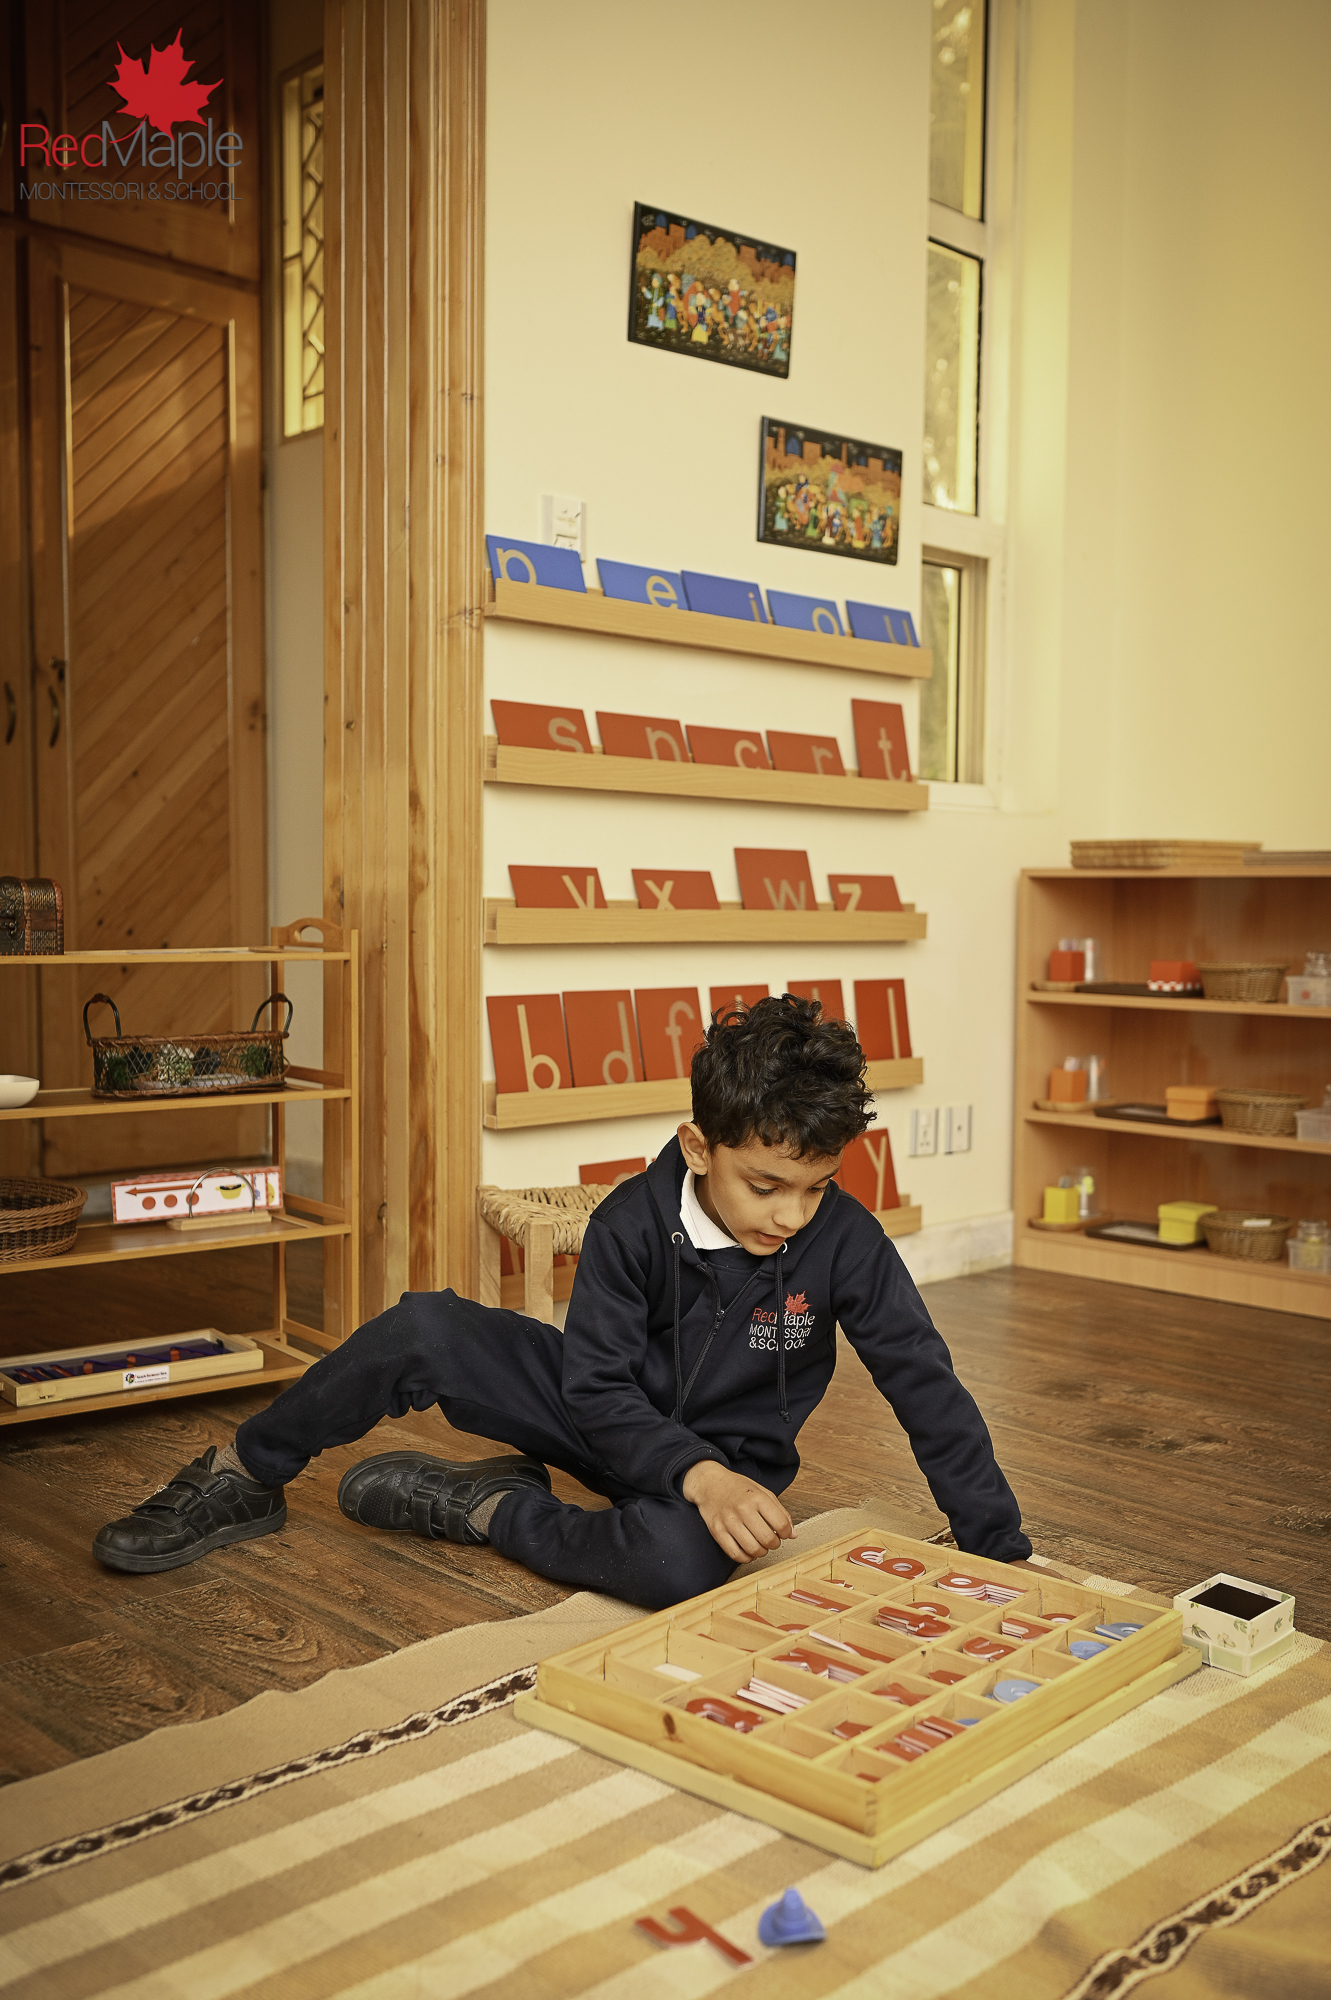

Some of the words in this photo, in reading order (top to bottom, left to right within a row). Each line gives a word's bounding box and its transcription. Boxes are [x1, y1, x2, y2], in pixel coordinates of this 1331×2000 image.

[646, 574, 678, 610] e
[548, 716, 584, 754] s
[877, 727, 912, 782] t
[517, 1003, 561, 1092] b
[602, 1001, 637, 1085] d
[749, 1323, 812, 1339] MONTSSORI
